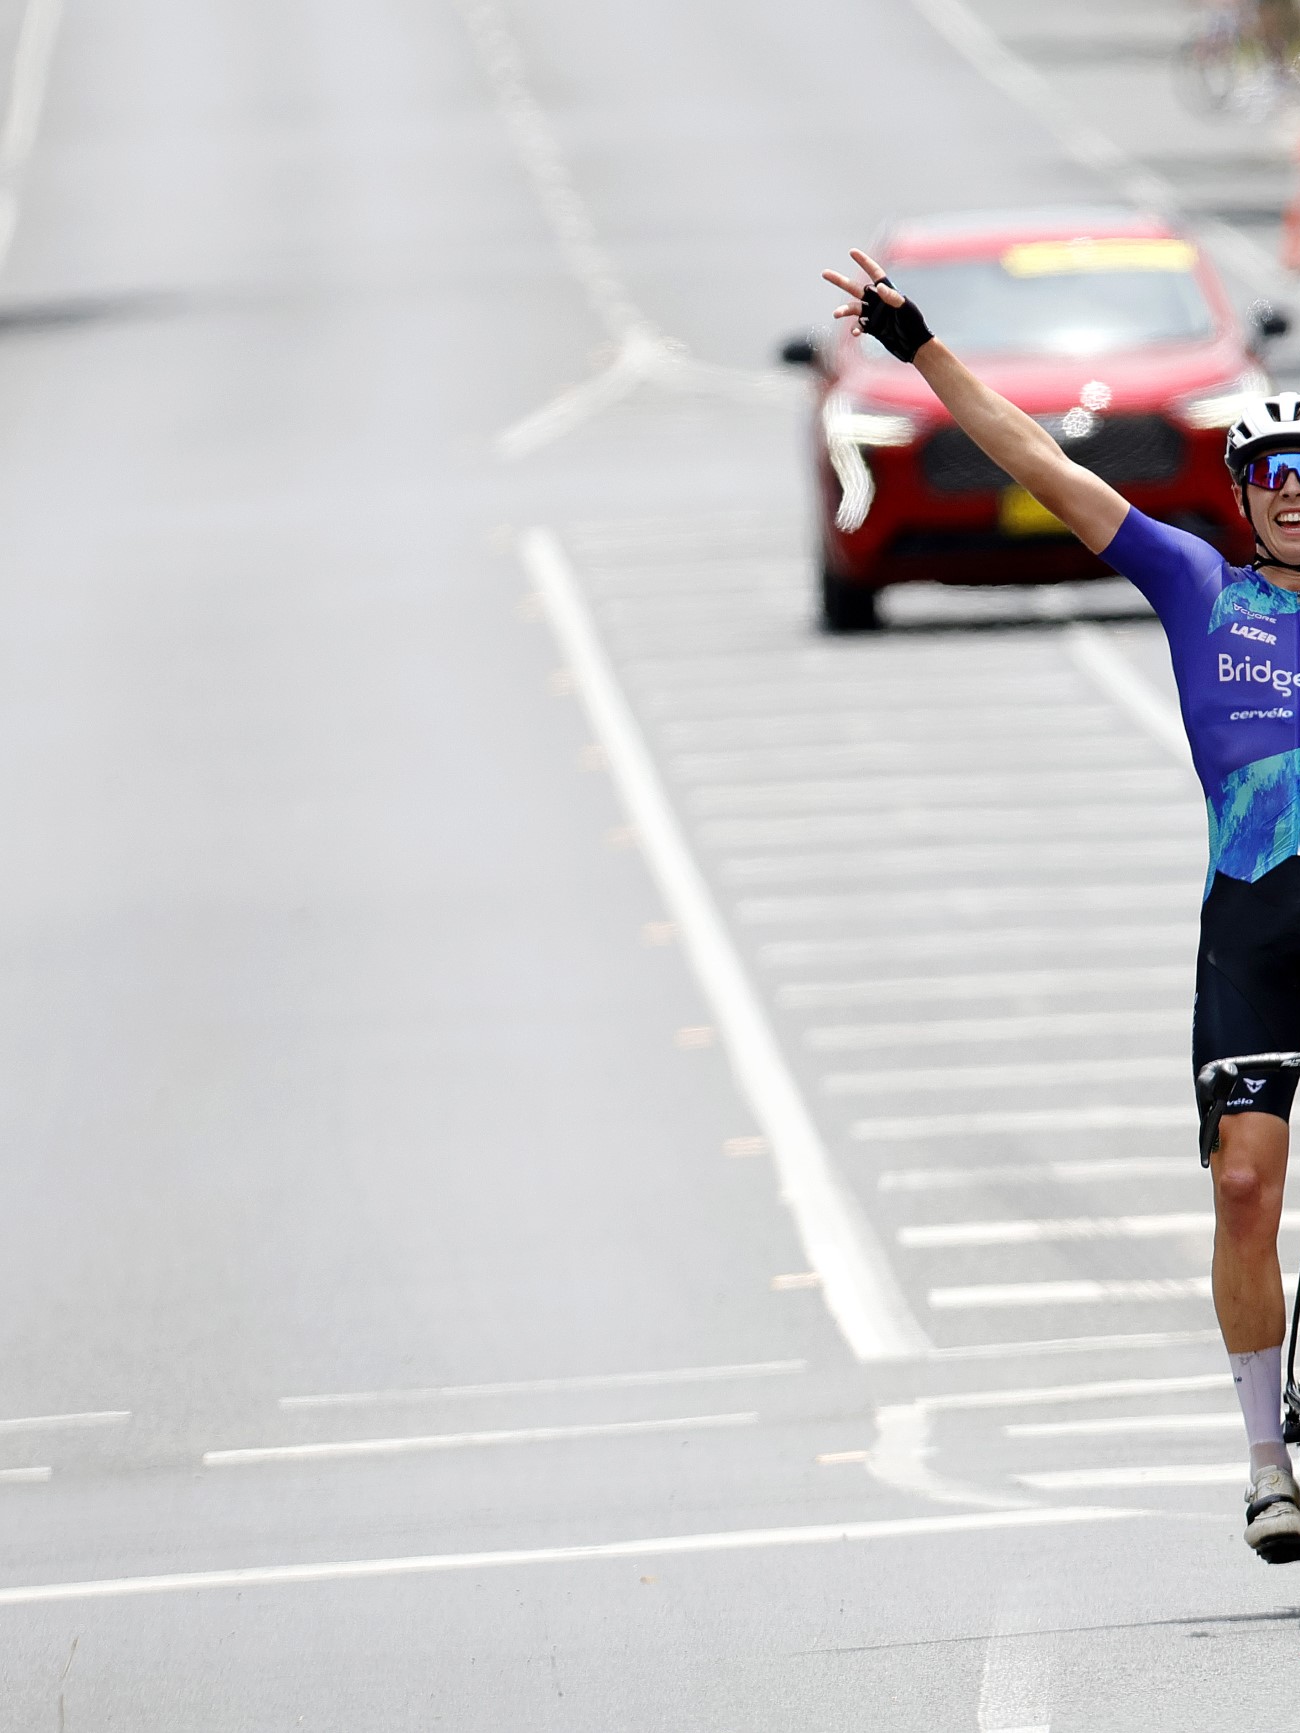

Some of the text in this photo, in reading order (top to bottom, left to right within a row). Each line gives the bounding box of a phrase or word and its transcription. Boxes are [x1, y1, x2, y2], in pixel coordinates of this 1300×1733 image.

[1230, 622, 1277, 645] LAZER
[1230, 707, 1293, 720] cervélo
[1226, 1097, 1254, 1107] vélo
